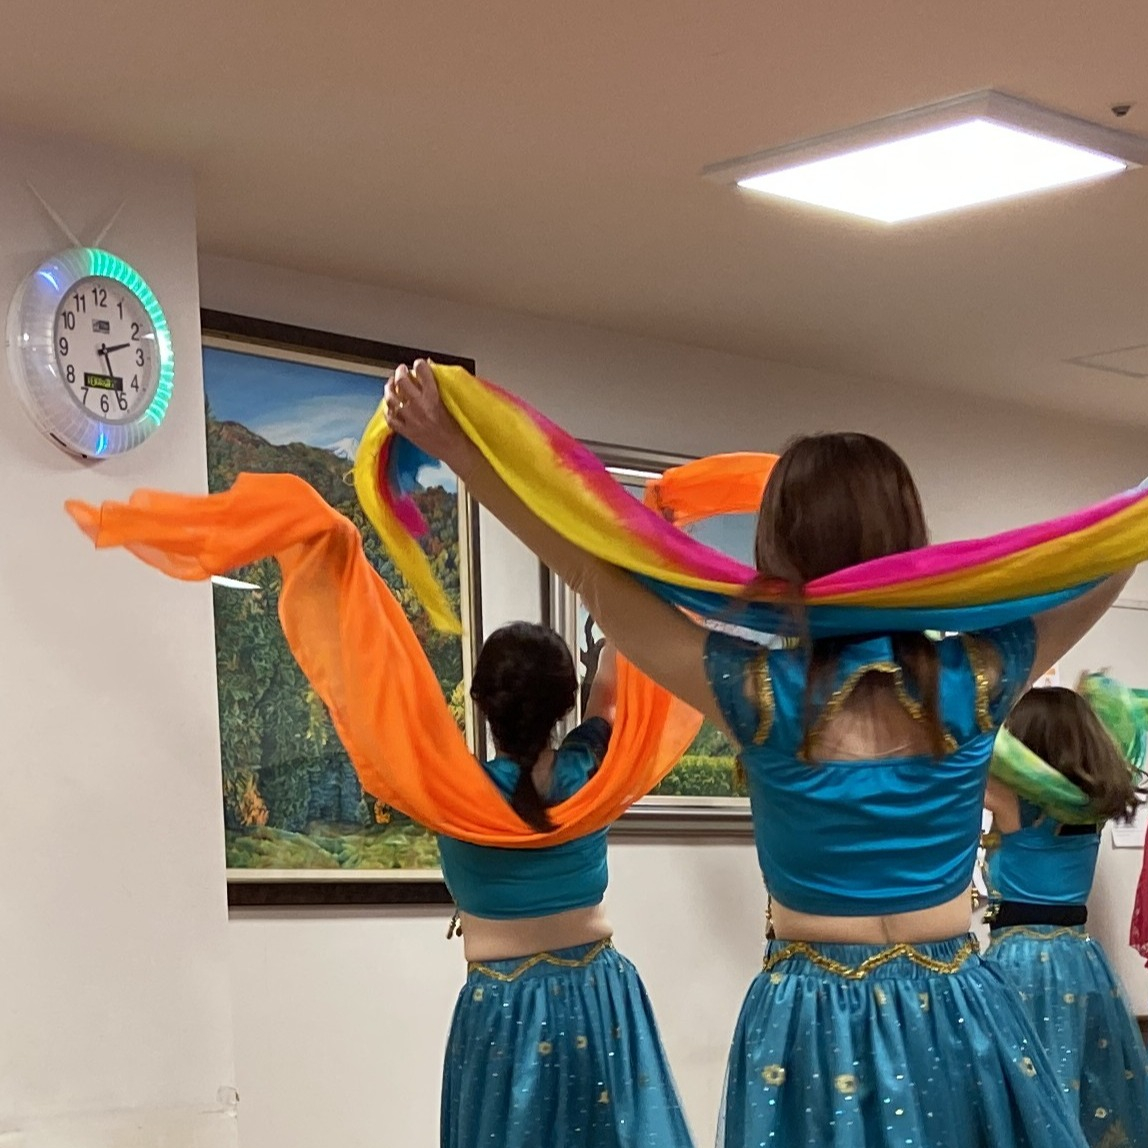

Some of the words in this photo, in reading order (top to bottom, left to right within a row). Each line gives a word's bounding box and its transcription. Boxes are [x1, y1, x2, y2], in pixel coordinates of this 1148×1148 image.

[73, 294, 86, 313] 11
[92, 287, 107, 308] 12
[117, 301, 123, 320] 1
[62, 311, 75, 330] 10
[131, 322, 140, 341] 2
[59, 337, 69, 356] 9
[135, 348, 145, 367] 3
[66, 364, 76, 384] 8
[130, 374, 139, 393] 4
[81, 386, 89, 405] 7
[100, 394, 109, 413] 6
